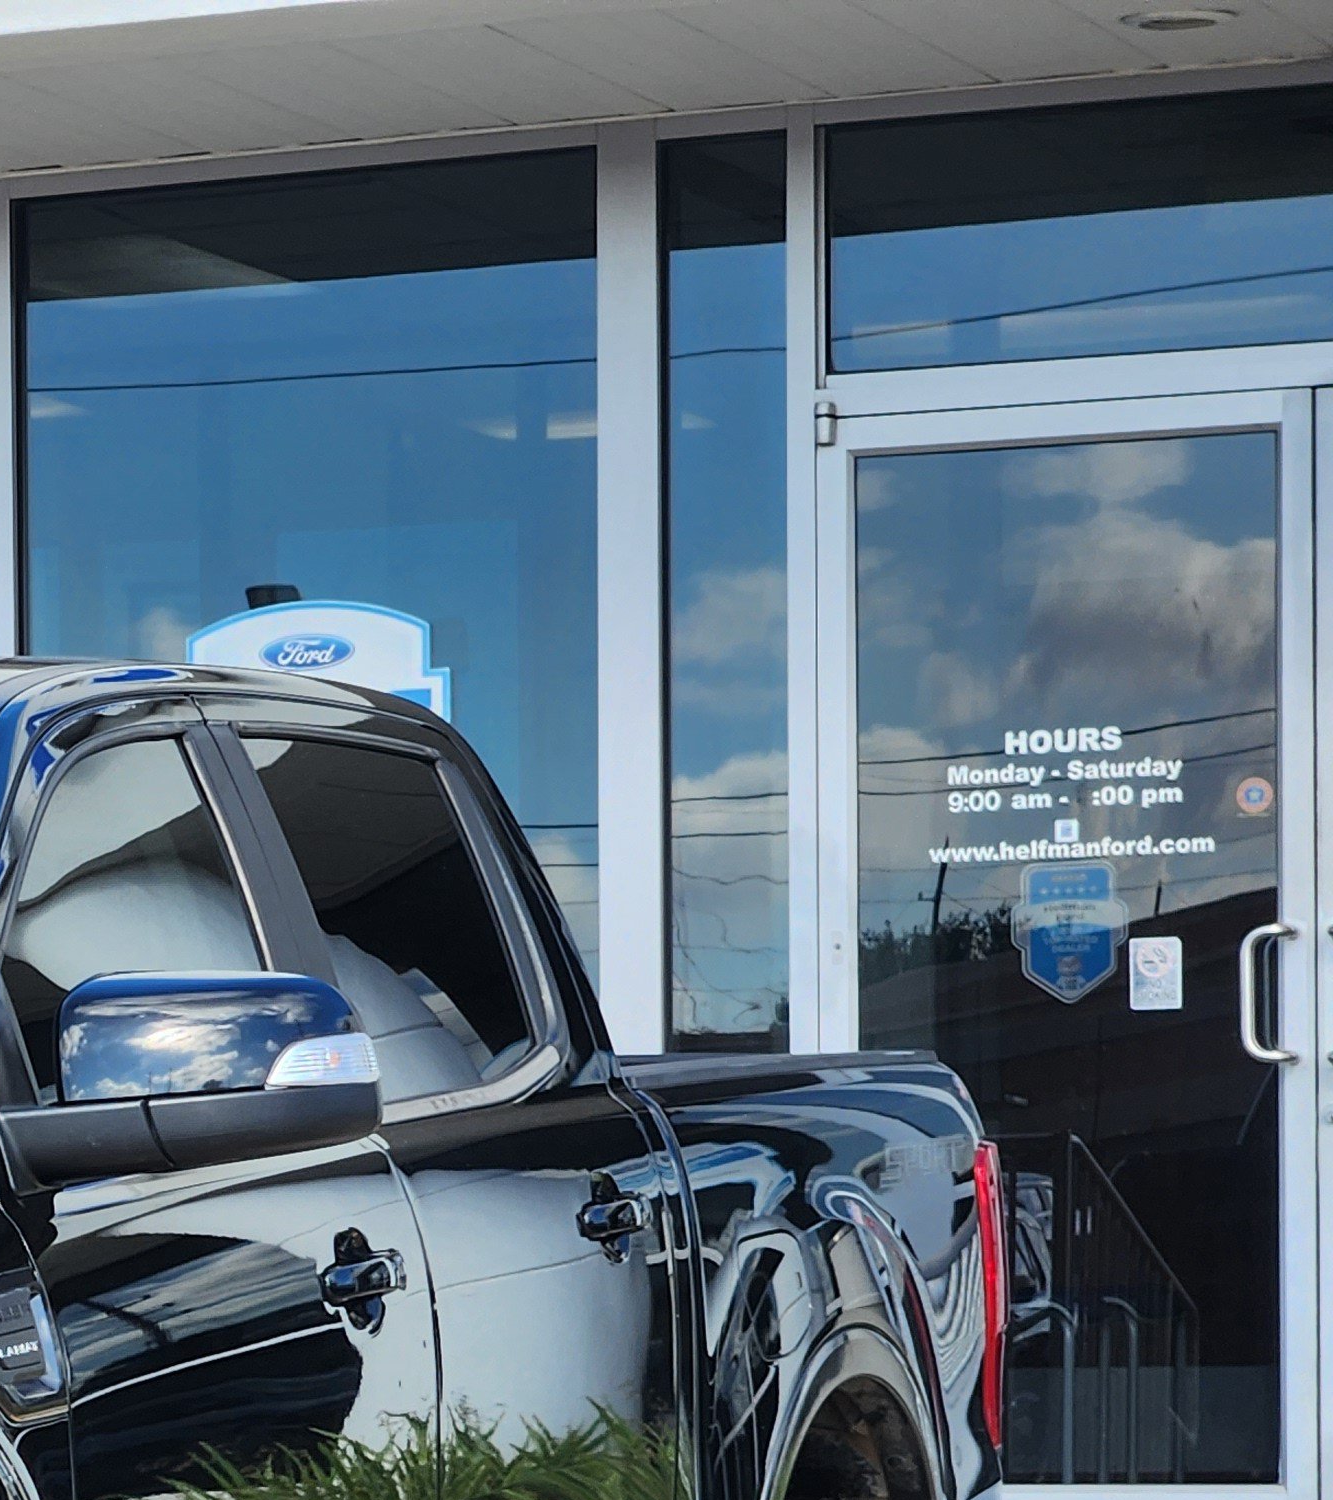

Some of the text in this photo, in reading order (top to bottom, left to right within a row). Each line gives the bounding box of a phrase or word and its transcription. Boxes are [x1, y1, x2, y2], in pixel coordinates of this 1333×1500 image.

[277, 638, 335, 667] Ford
[1004, 725, 1123, 755] HOURS
[946, 763, 1046, 787] Monday
[1067, 756, 1183, 781] Saturday
[947, 790, 1002, 813] 9:00
[1010, 793, 1053, 810] am
[1141, 786, 1183, 809] pm
[929, 835, 1216, 864] www.helfmanford.com
